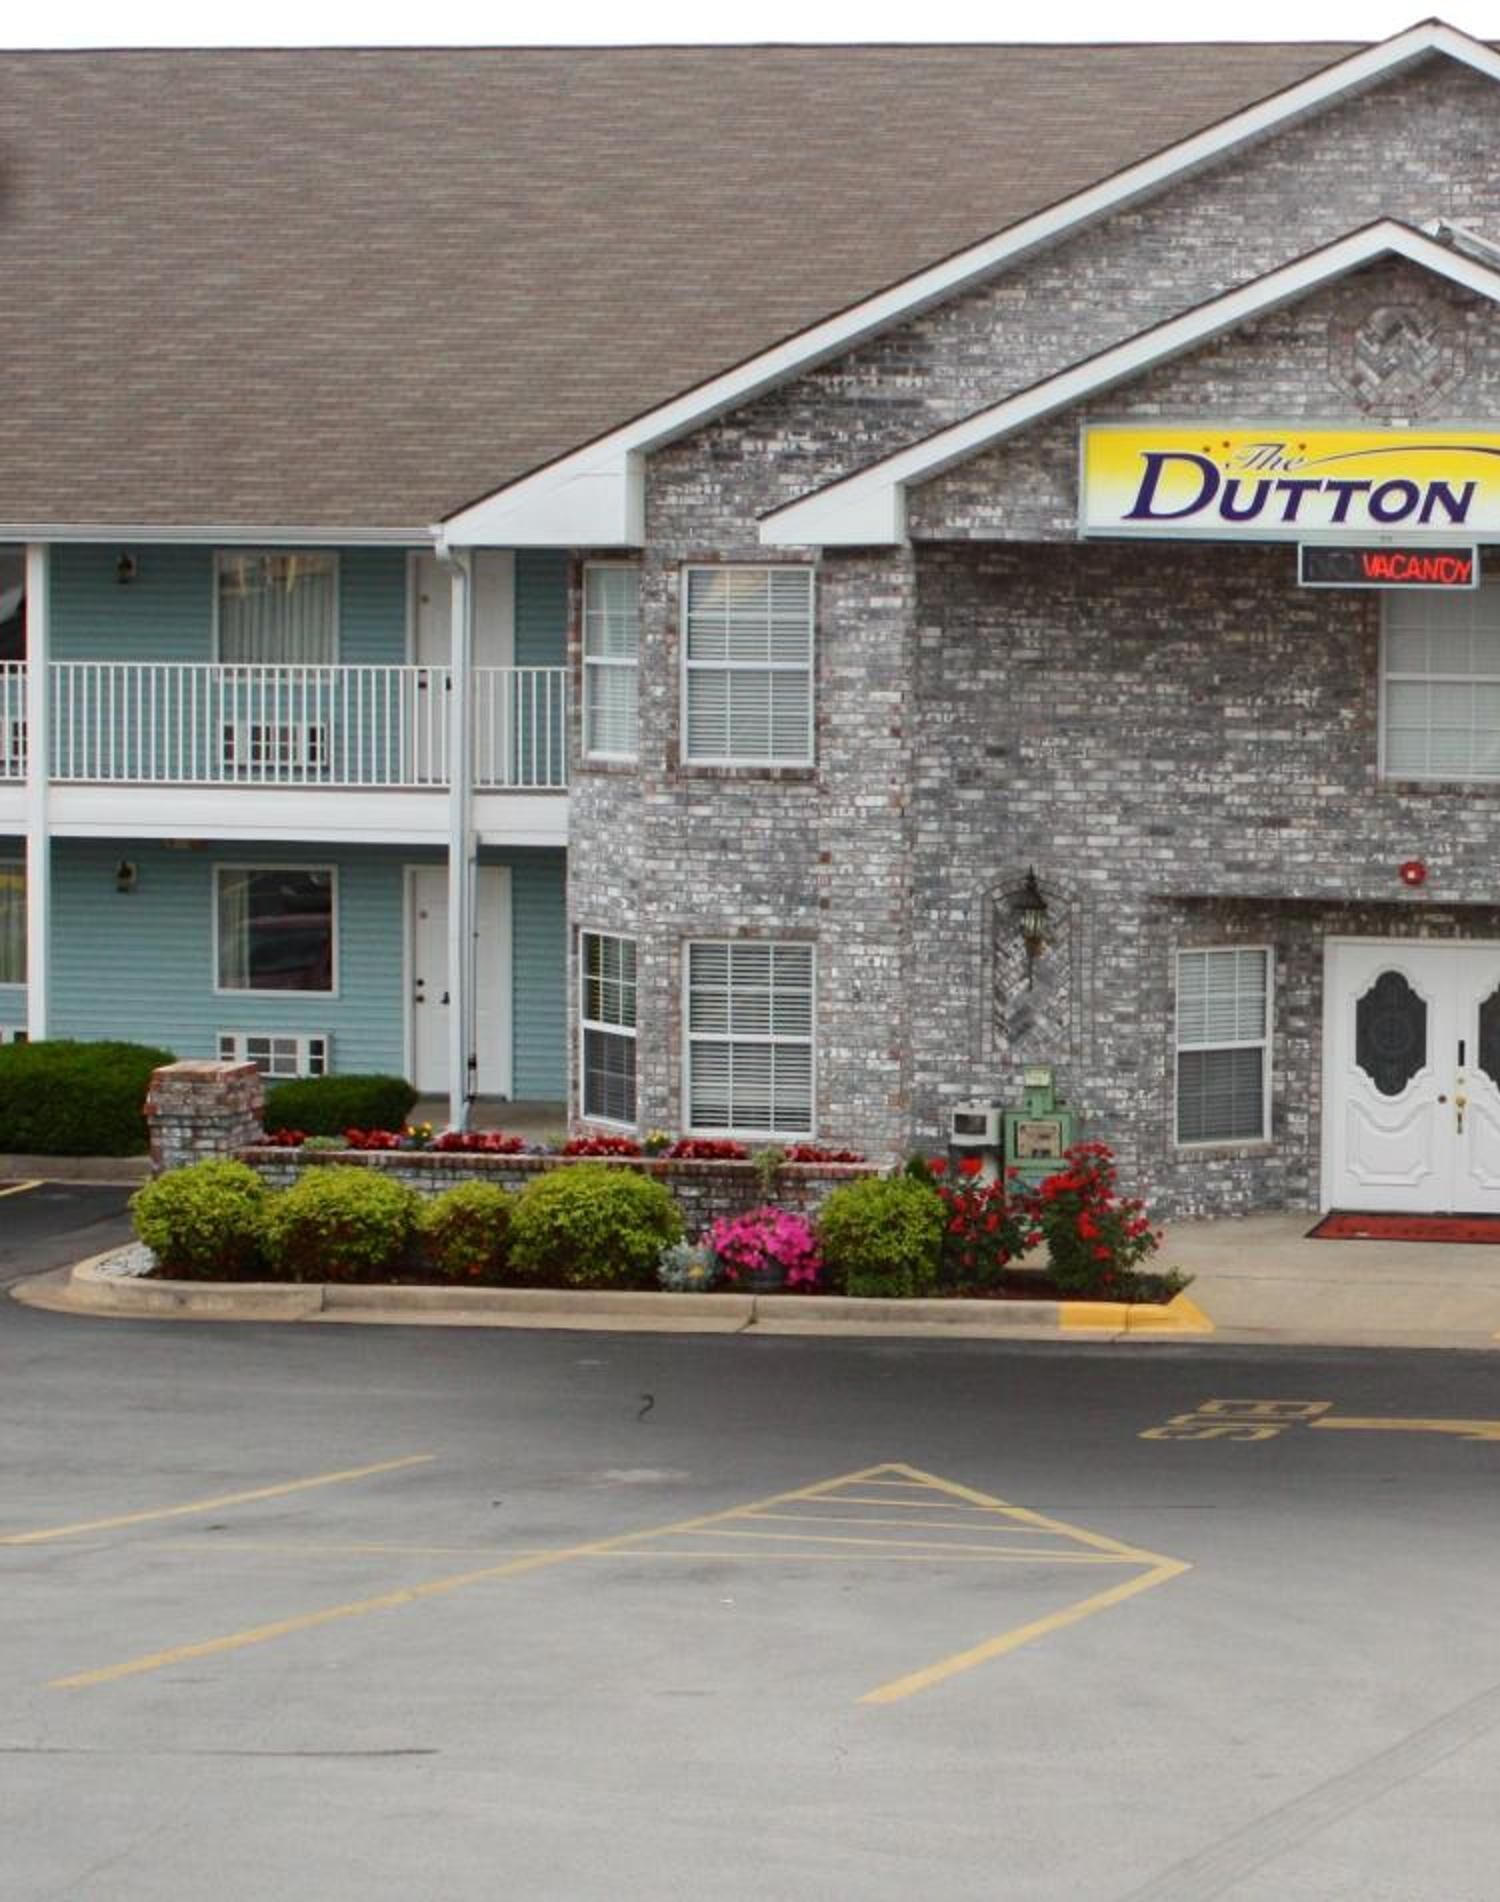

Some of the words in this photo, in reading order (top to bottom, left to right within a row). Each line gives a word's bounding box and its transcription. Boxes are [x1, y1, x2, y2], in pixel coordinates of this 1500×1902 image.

[1235, 443, 1306, 471] The
[1123, 452, 1476, 523] DUTTON
[1363, 553, 1472, 583] VACANCY
